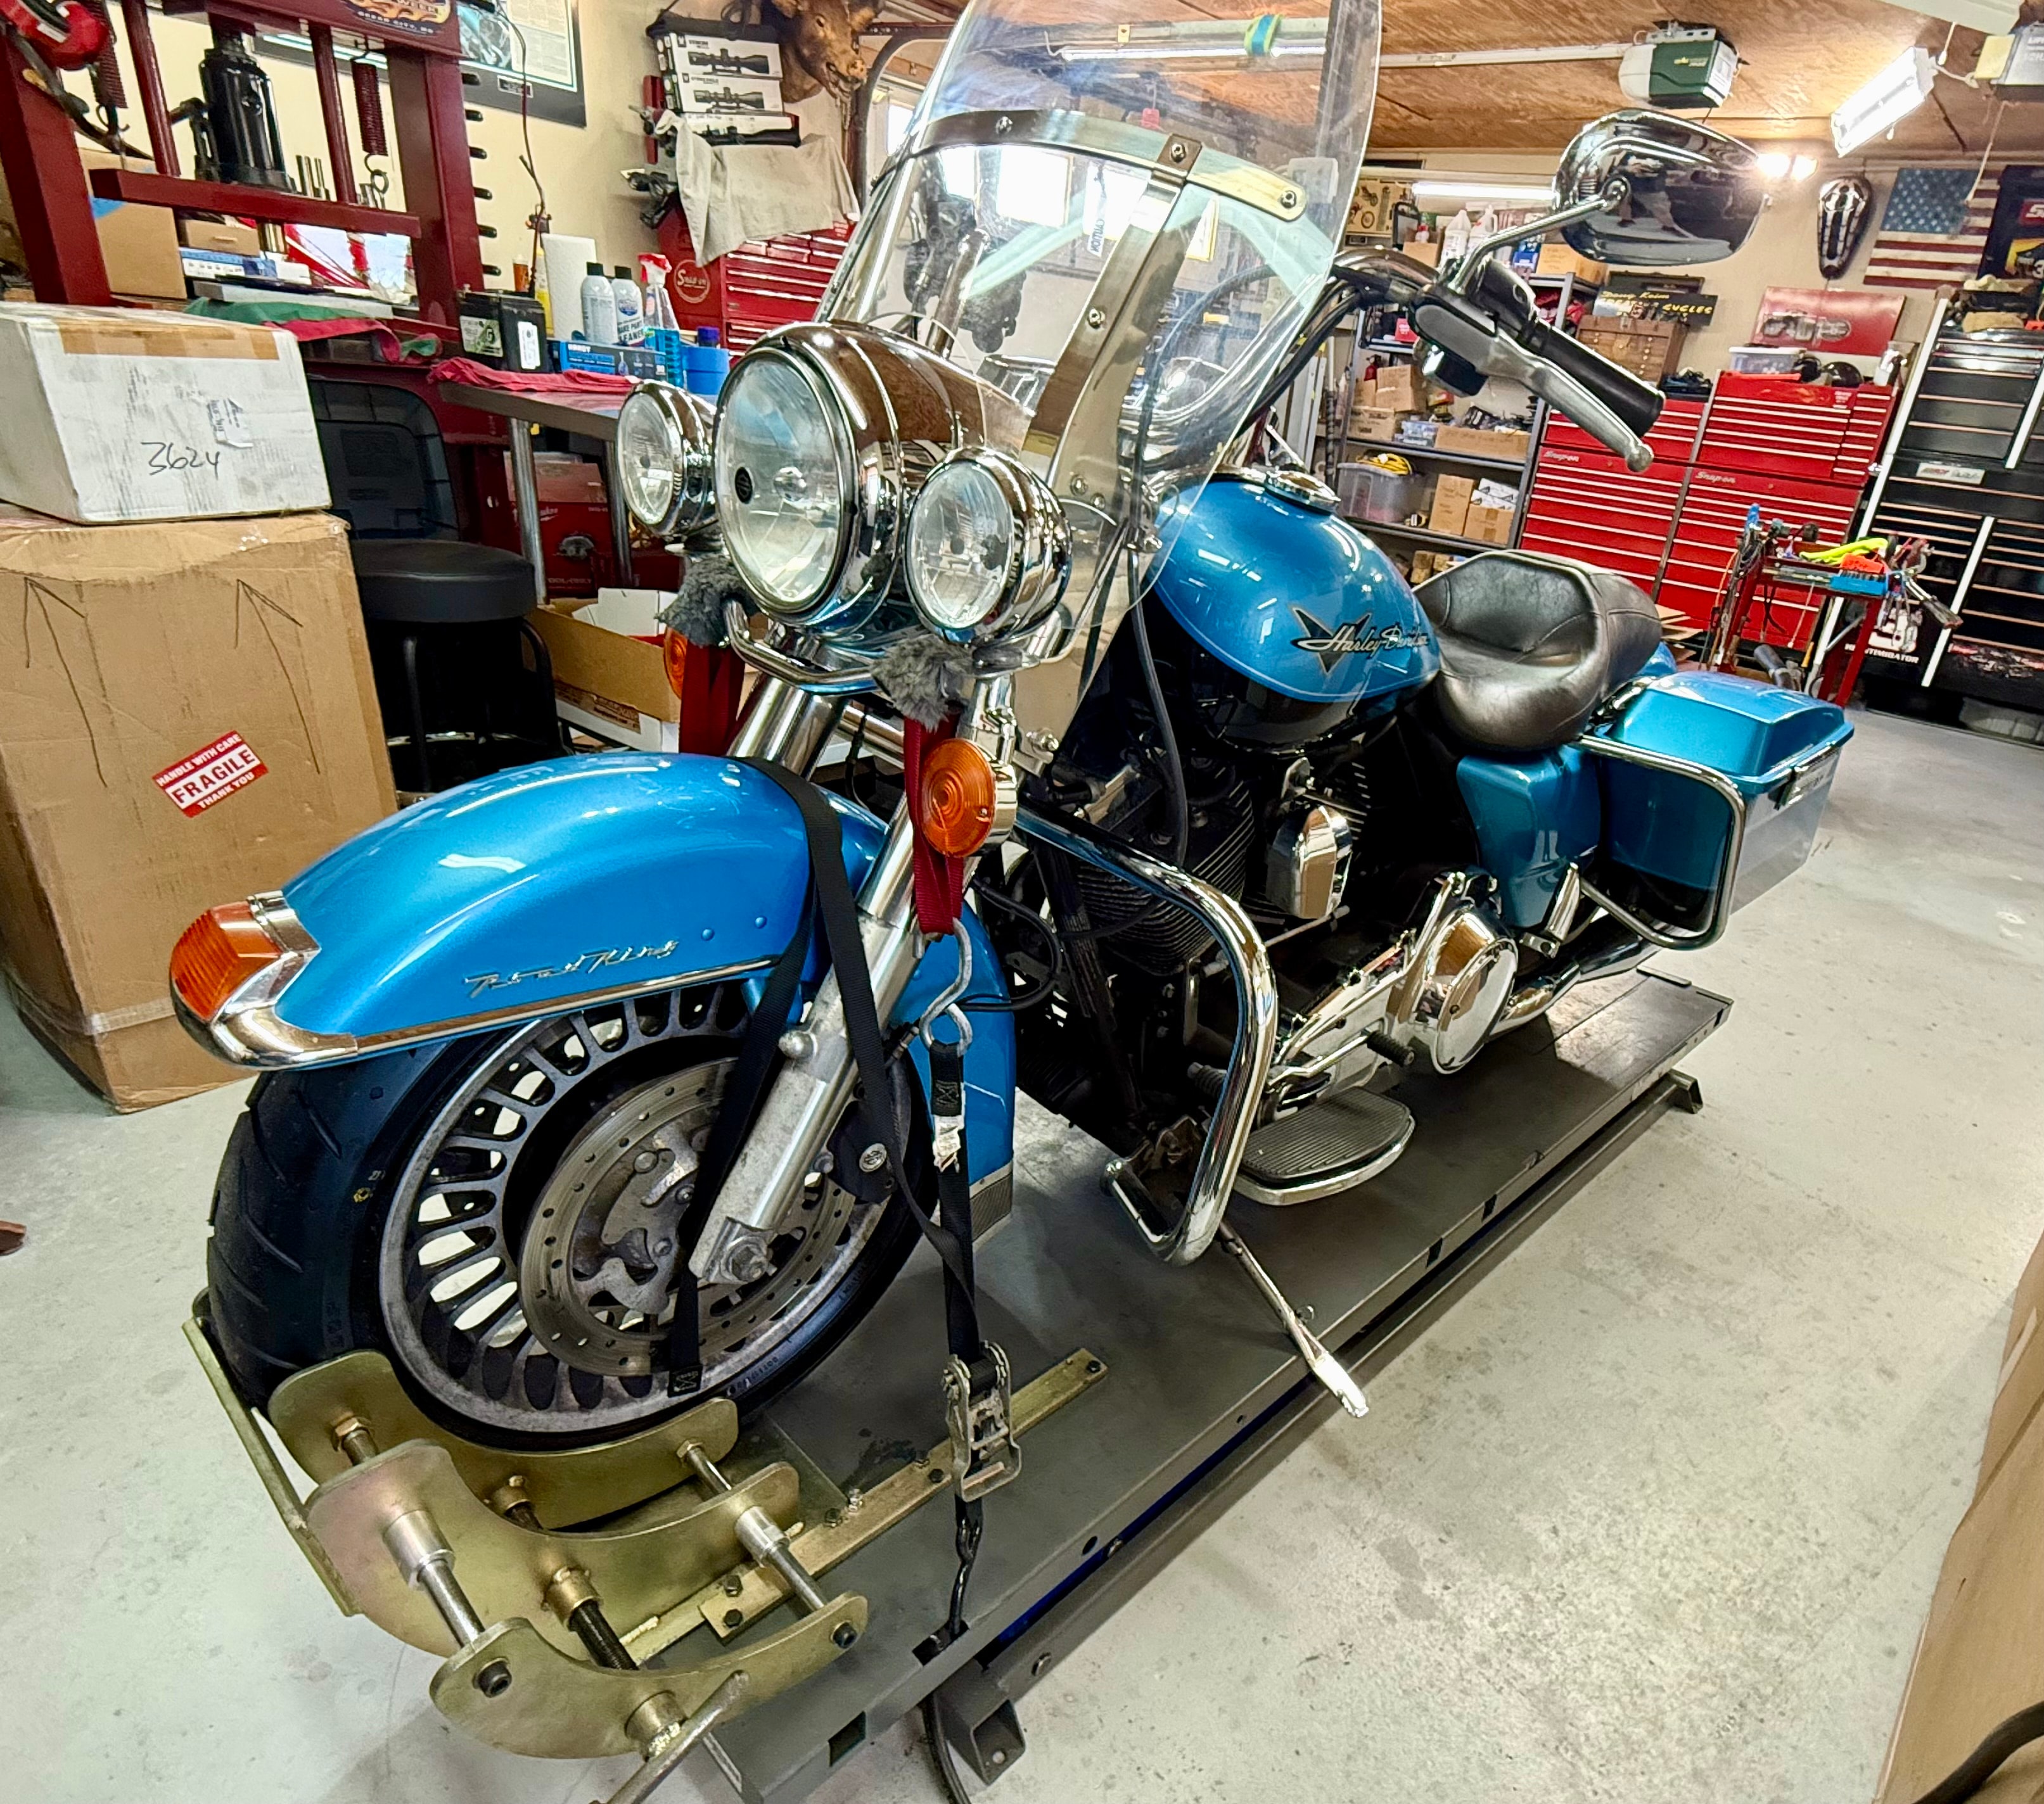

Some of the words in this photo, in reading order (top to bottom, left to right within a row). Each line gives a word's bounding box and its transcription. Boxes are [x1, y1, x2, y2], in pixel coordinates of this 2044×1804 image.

[141, 441, 220, 480] 3624
[1544, 450, 1580, 462] Snap-on
[1695, 471, 1735, 484] Snap-on
[156, 762, 195, 787] HANDLE
[191, 748, 218, 766] WITH
[215, 734, 242, 753] CARE
[171, 749, 255, 803] FRAGILE
[197, 784, 234, 809] THANK
[232, 772, 255, 788] YOU
